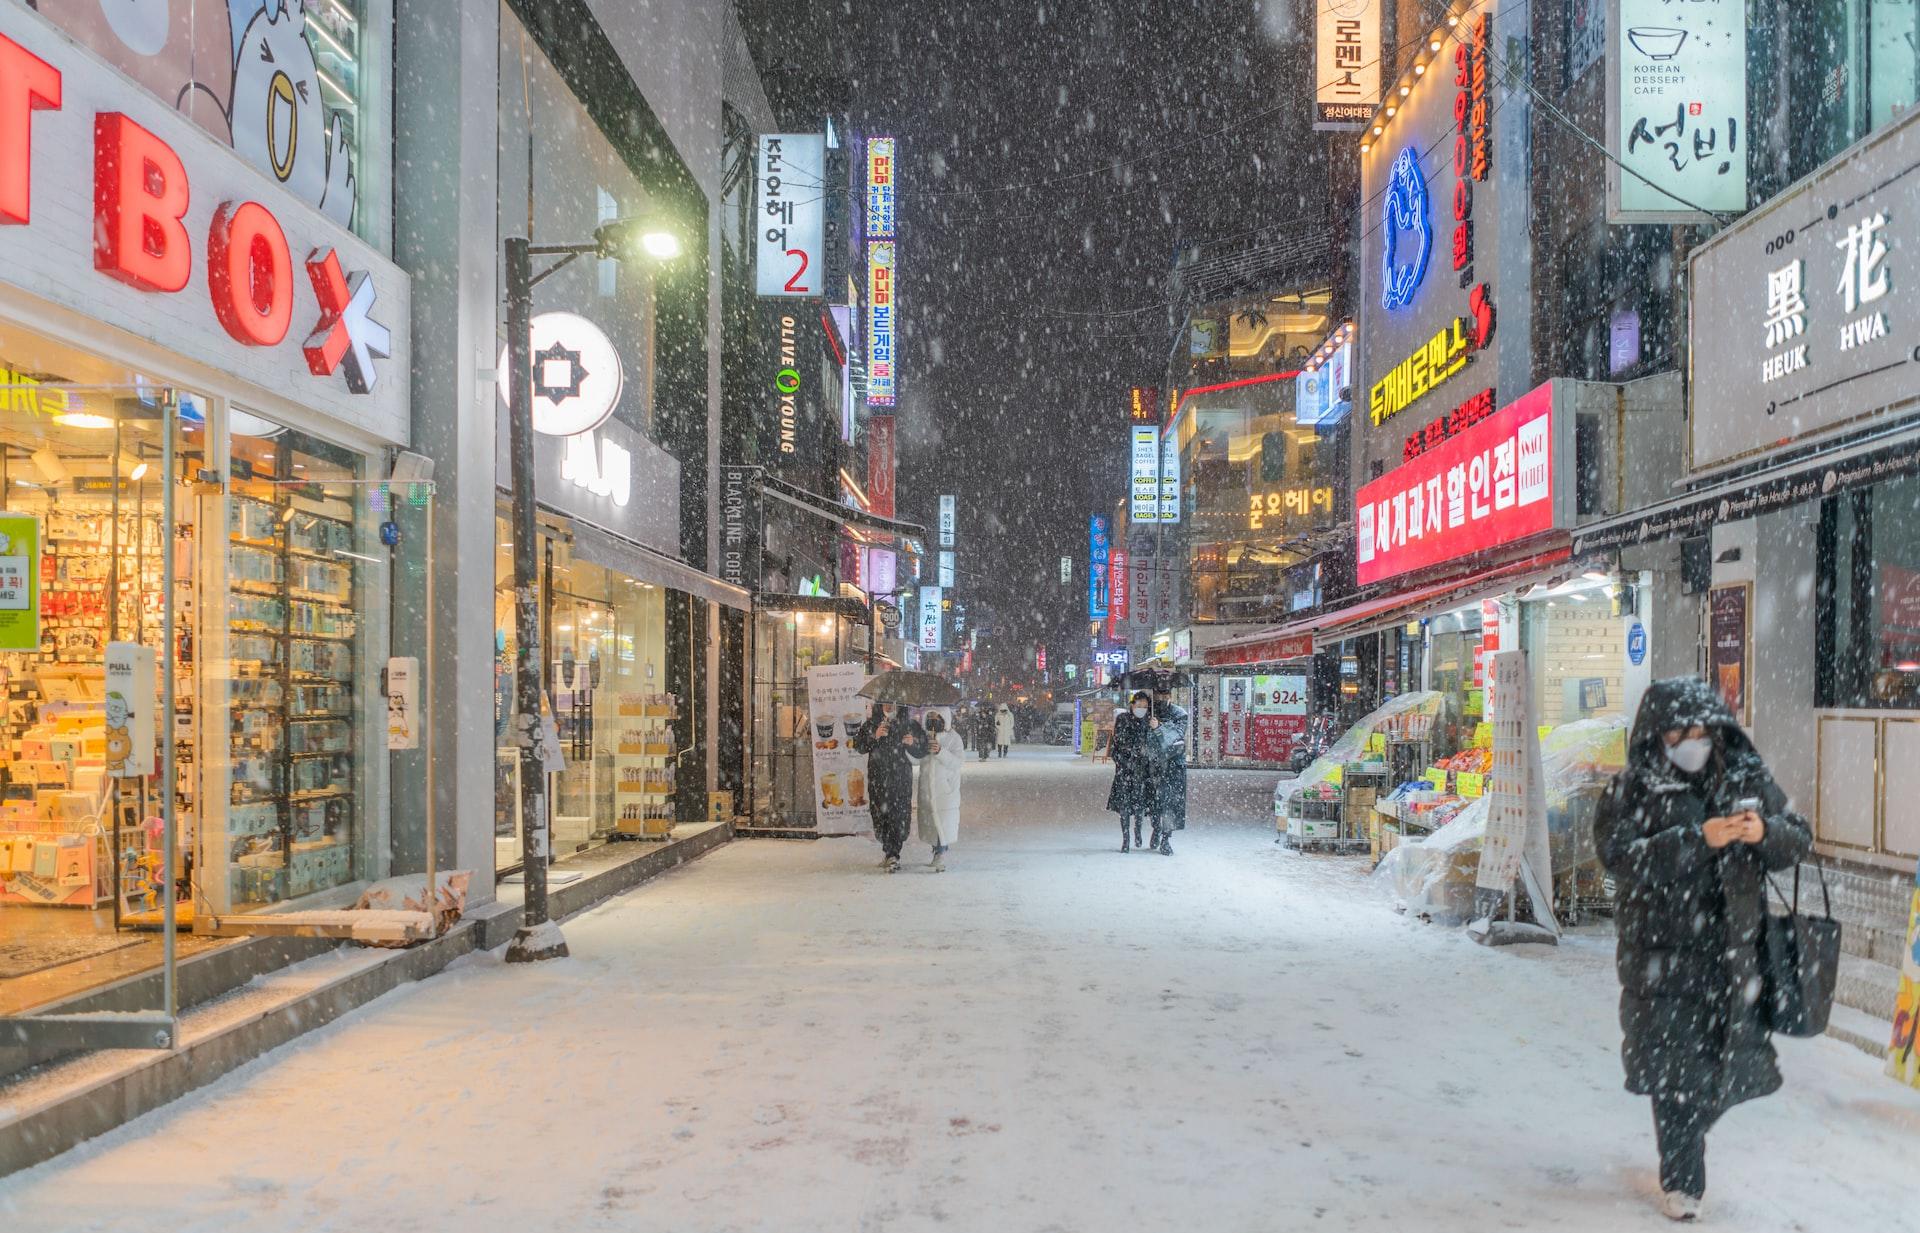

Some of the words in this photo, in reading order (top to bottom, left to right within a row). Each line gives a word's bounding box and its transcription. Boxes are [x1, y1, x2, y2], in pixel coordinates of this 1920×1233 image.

[1634, 65, 1681, 73] KOREAN
[1634, 76, 1685, 84] DESSERT
[1634, 87, 1665, 95] CAFE
[1325, 106, 1373, 119] 성신여대점
[1628, 102, 1737, 175] 설빙
[766, 139, 793, 250] 준오헤어
[784, 249, 809, 292] 2
[94, 112, 391, 395] BOX
[1836, 211, 1888, 314] 花
[781, 316, 795, 367] OLIVE
[873, 306, 889, 360] 보드게임
[1762, 343, 1808, 384] HEUK
[1840, 310, 1886, 351] HWA
[781, 395, 795, 453] YOUNG
[1871, 460, 1884, 475] Tea
[1885, 454, 1911, 472] House
[726, 472, 743, 546] BLACKLINE
[1134, 503, 1155, 511] 베이글
[1251, 488, 1333, 529] 준오헤어
[109, 663, 131, 671] PULL
